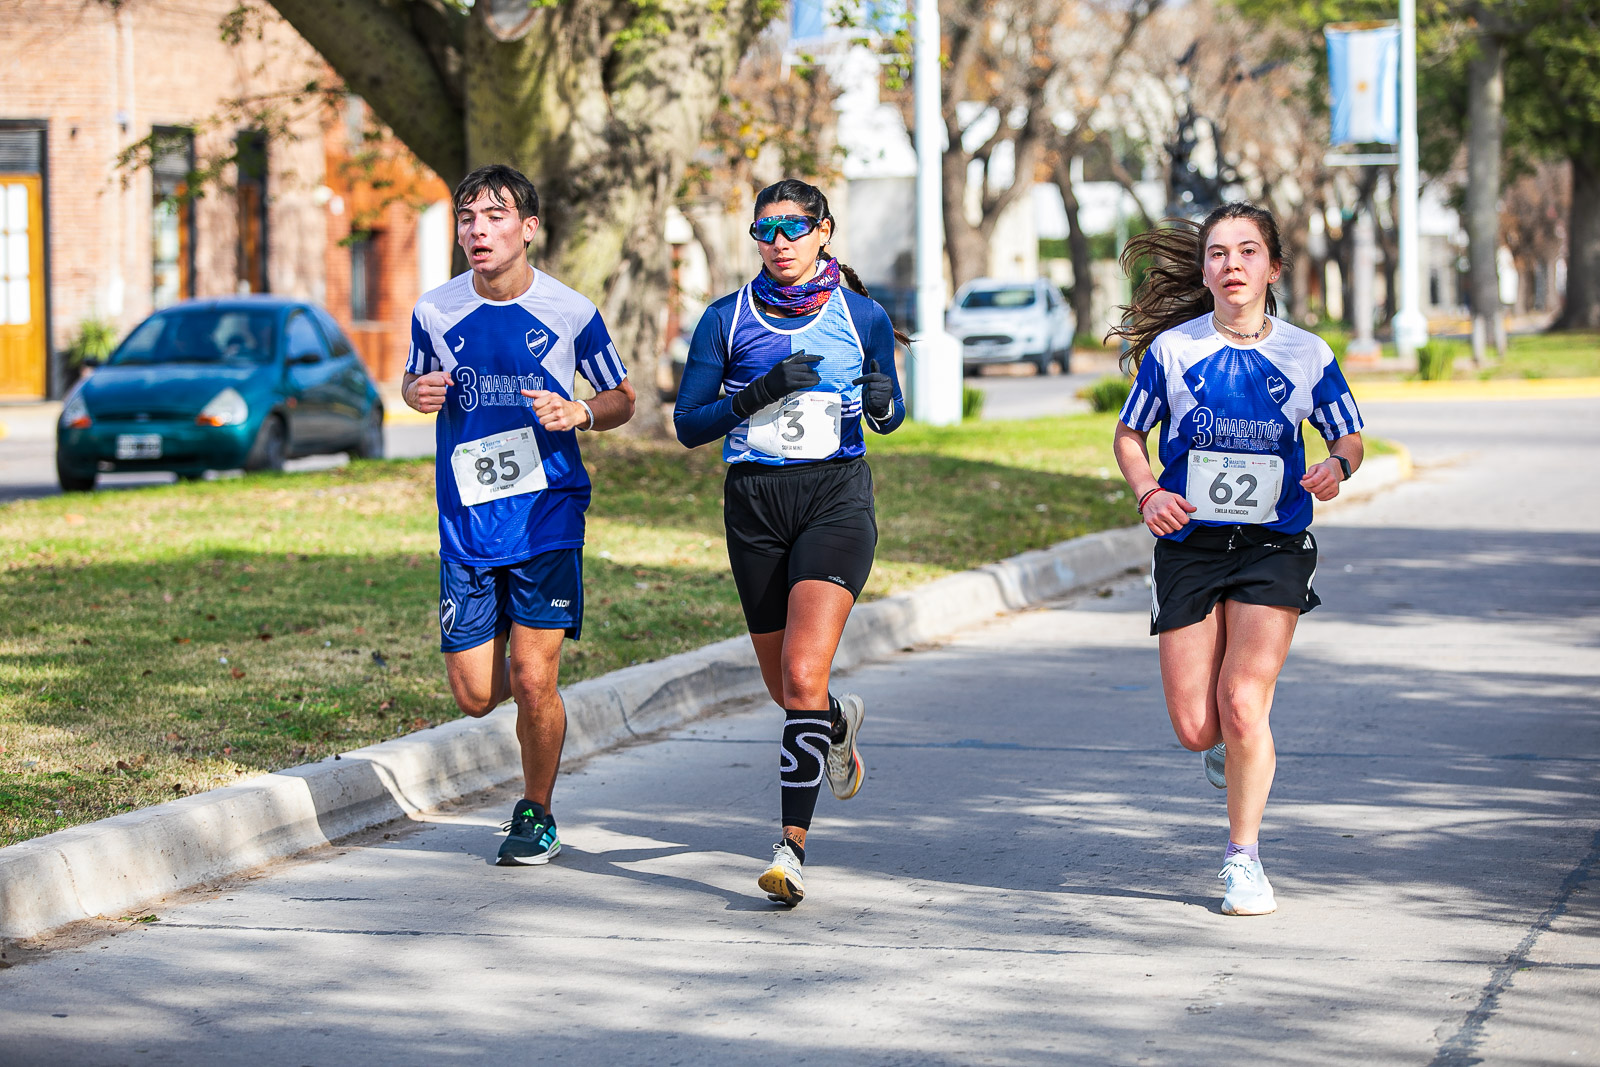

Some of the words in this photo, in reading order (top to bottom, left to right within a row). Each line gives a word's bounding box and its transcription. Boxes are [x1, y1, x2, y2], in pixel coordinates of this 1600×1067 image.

[456, 366, 479, 413] 3
[480, 372, 544, 394] MARATÓN
[781, 410, 805, 443] 3
[1192, 406, 1214, 449] 3
[1215, 417, 1284, 442] MARATÓN
[475, 450, 520, 486] 85
[1208, 472, 1258, 507] 62
